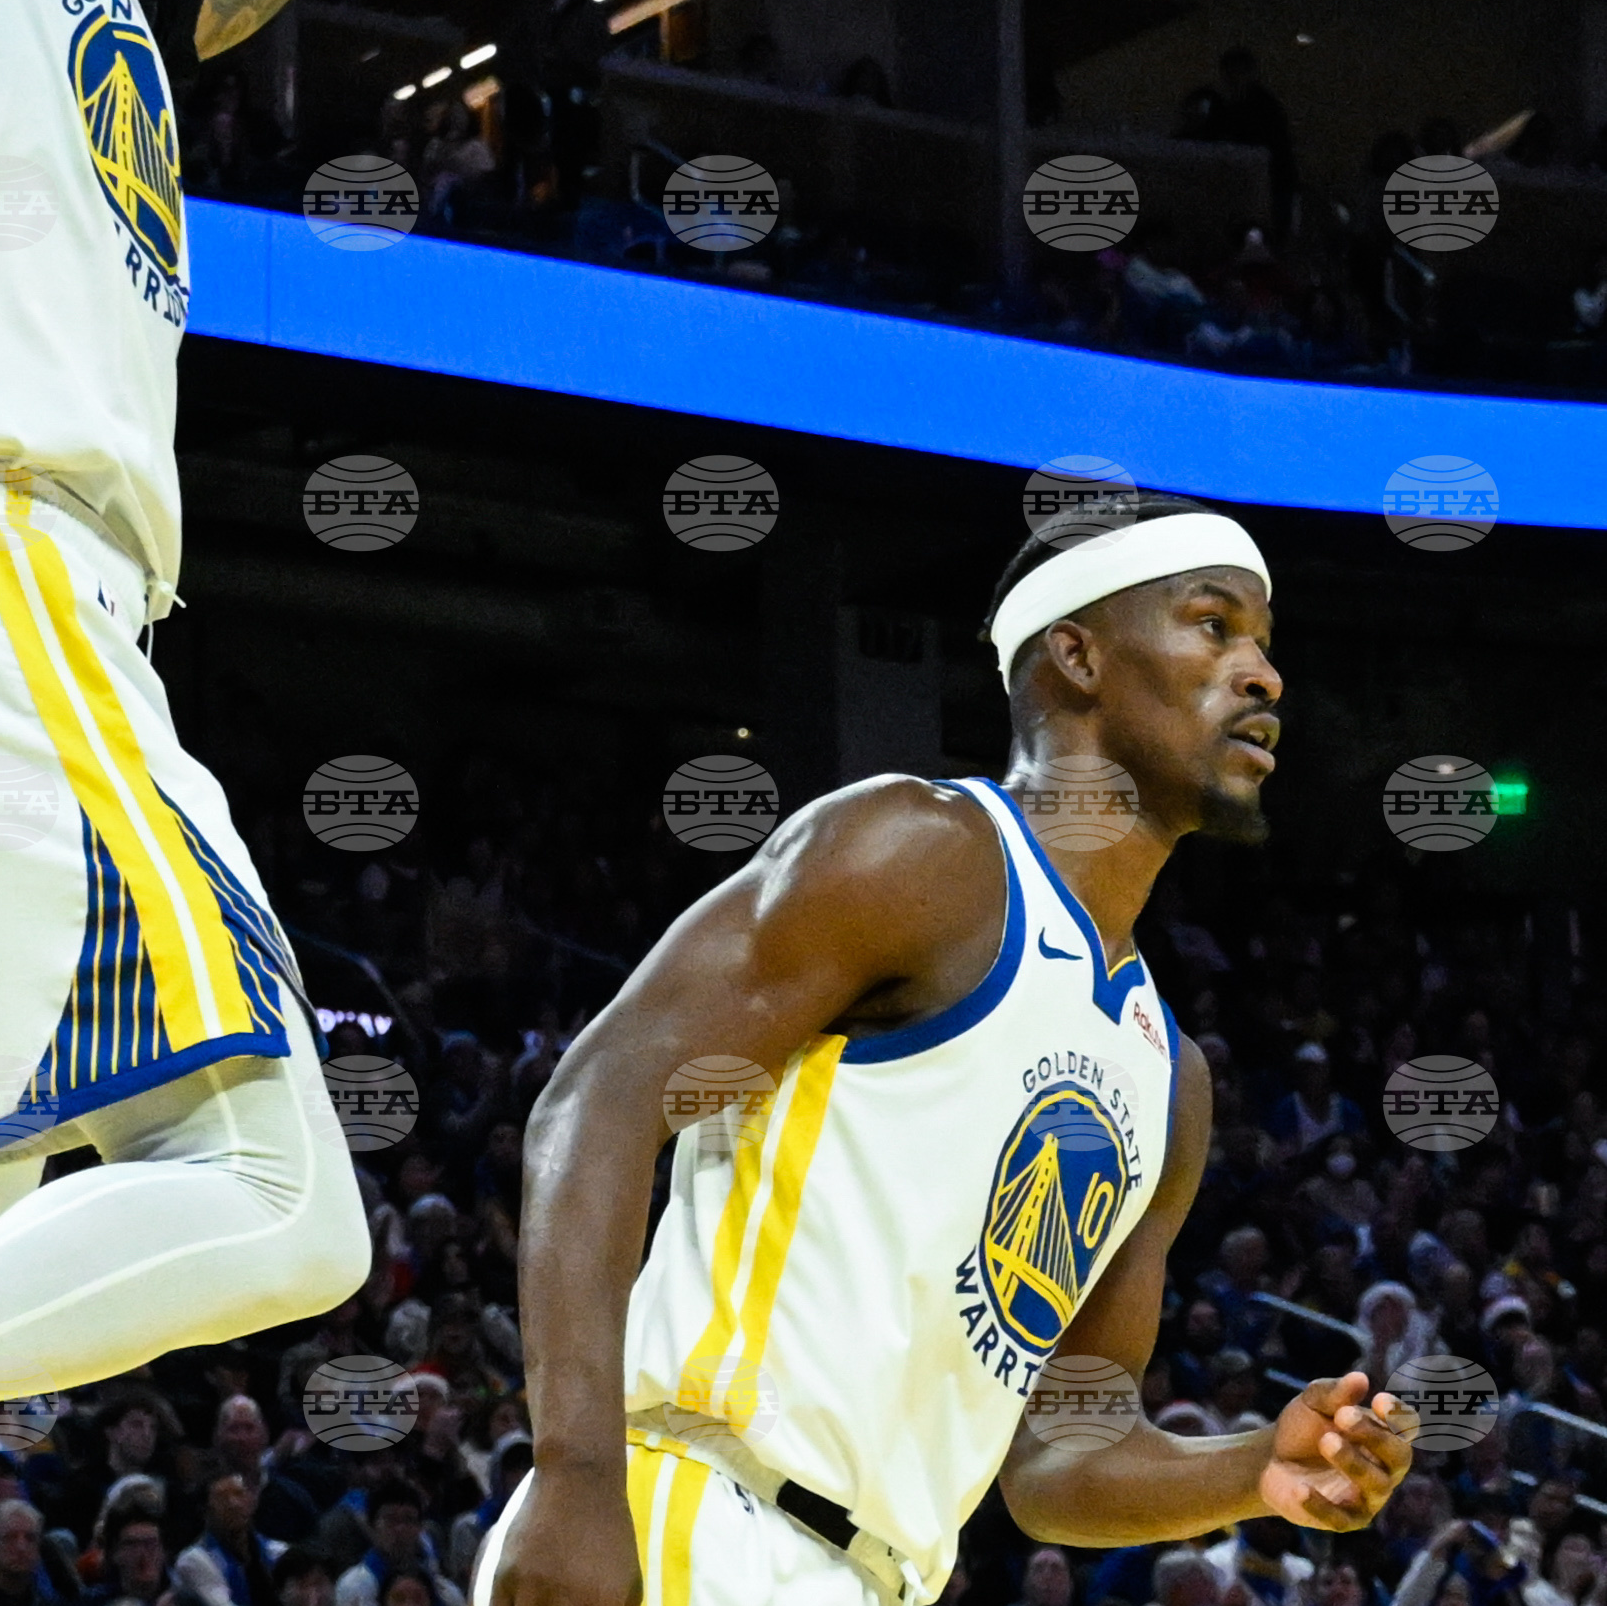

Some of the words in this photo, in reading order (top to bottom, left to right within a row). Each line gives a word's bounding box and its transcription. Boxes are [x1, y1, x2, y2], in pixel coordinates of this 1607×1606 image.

[1022, 1050, 1104, 1094] GOLDEN
[1110, 1088, 1142, 1191] STATE
[1076, 1172, 1115, 1250] 10
